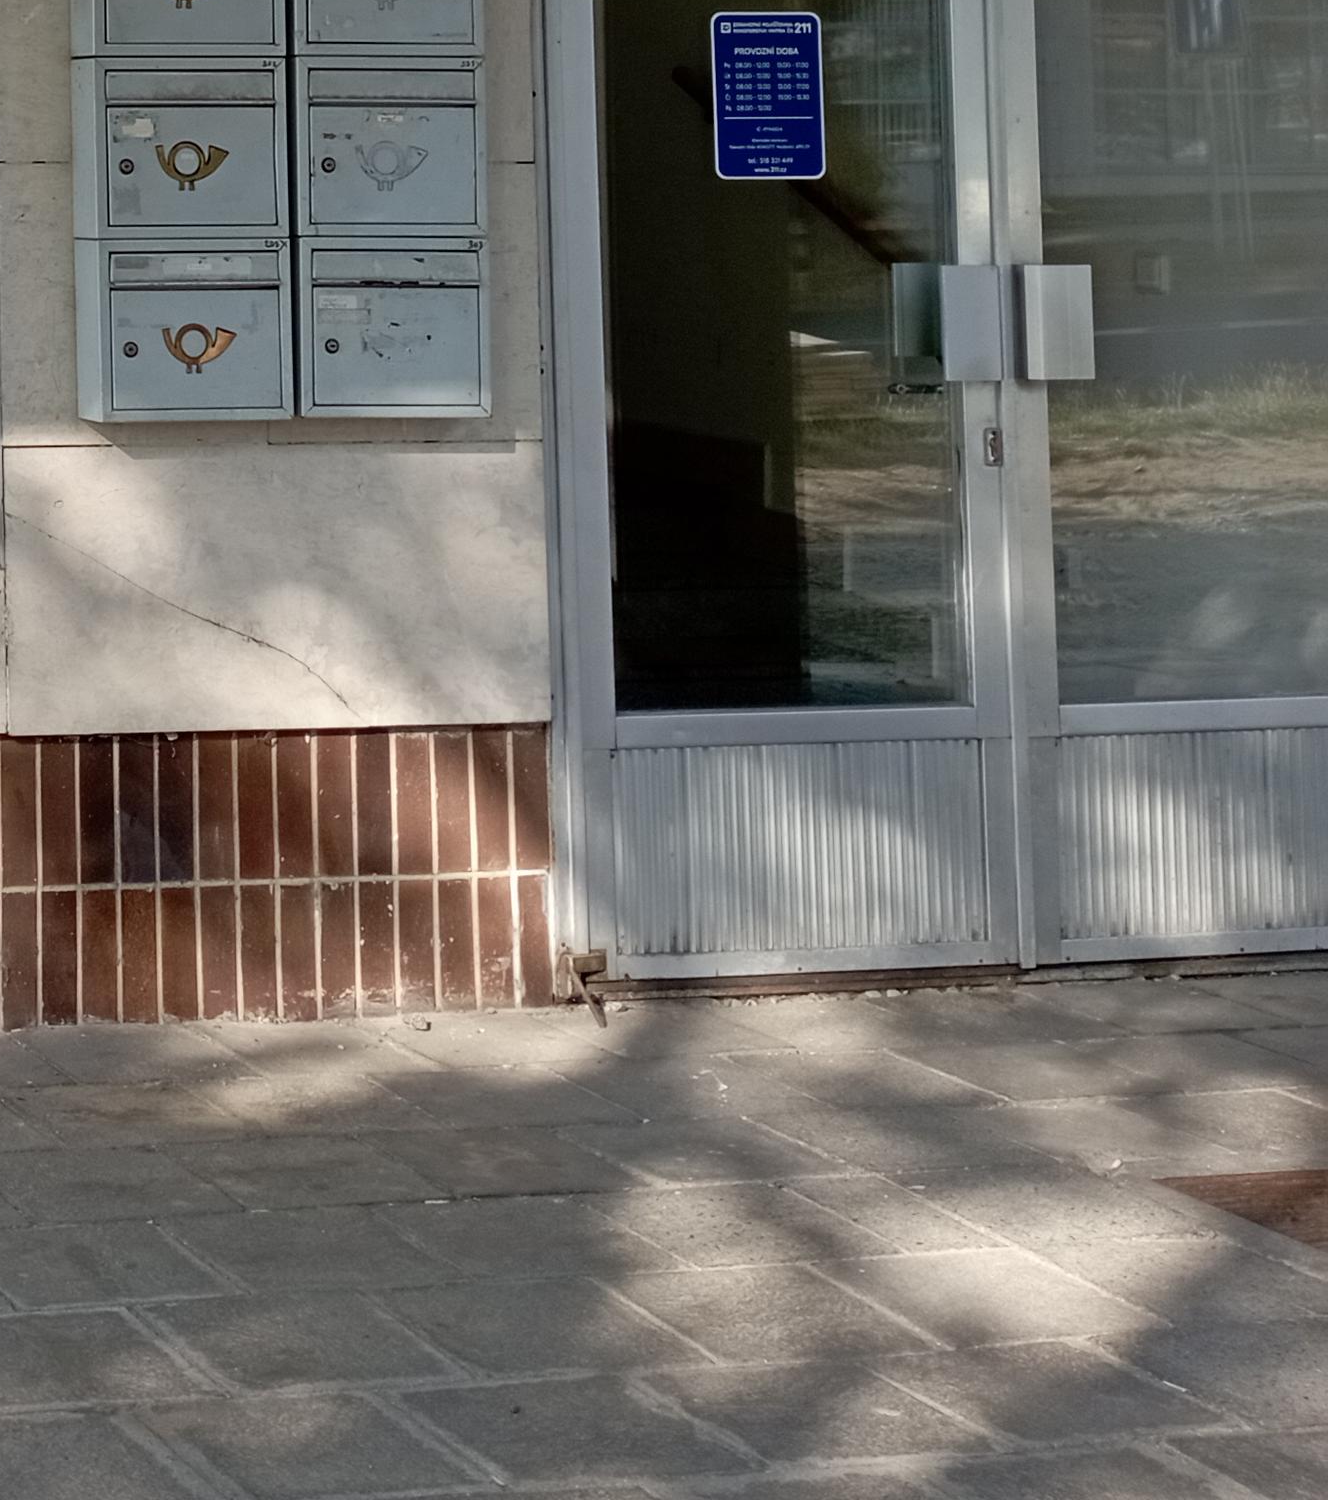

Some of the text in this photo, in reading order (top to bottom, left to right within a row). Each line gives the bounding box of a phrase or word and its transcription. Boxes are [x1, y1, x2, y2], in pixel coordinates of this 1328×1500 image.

[794, 22, 812, 34] 211
[734, 46, 799, 55] PROVOZNÍ DOBA
